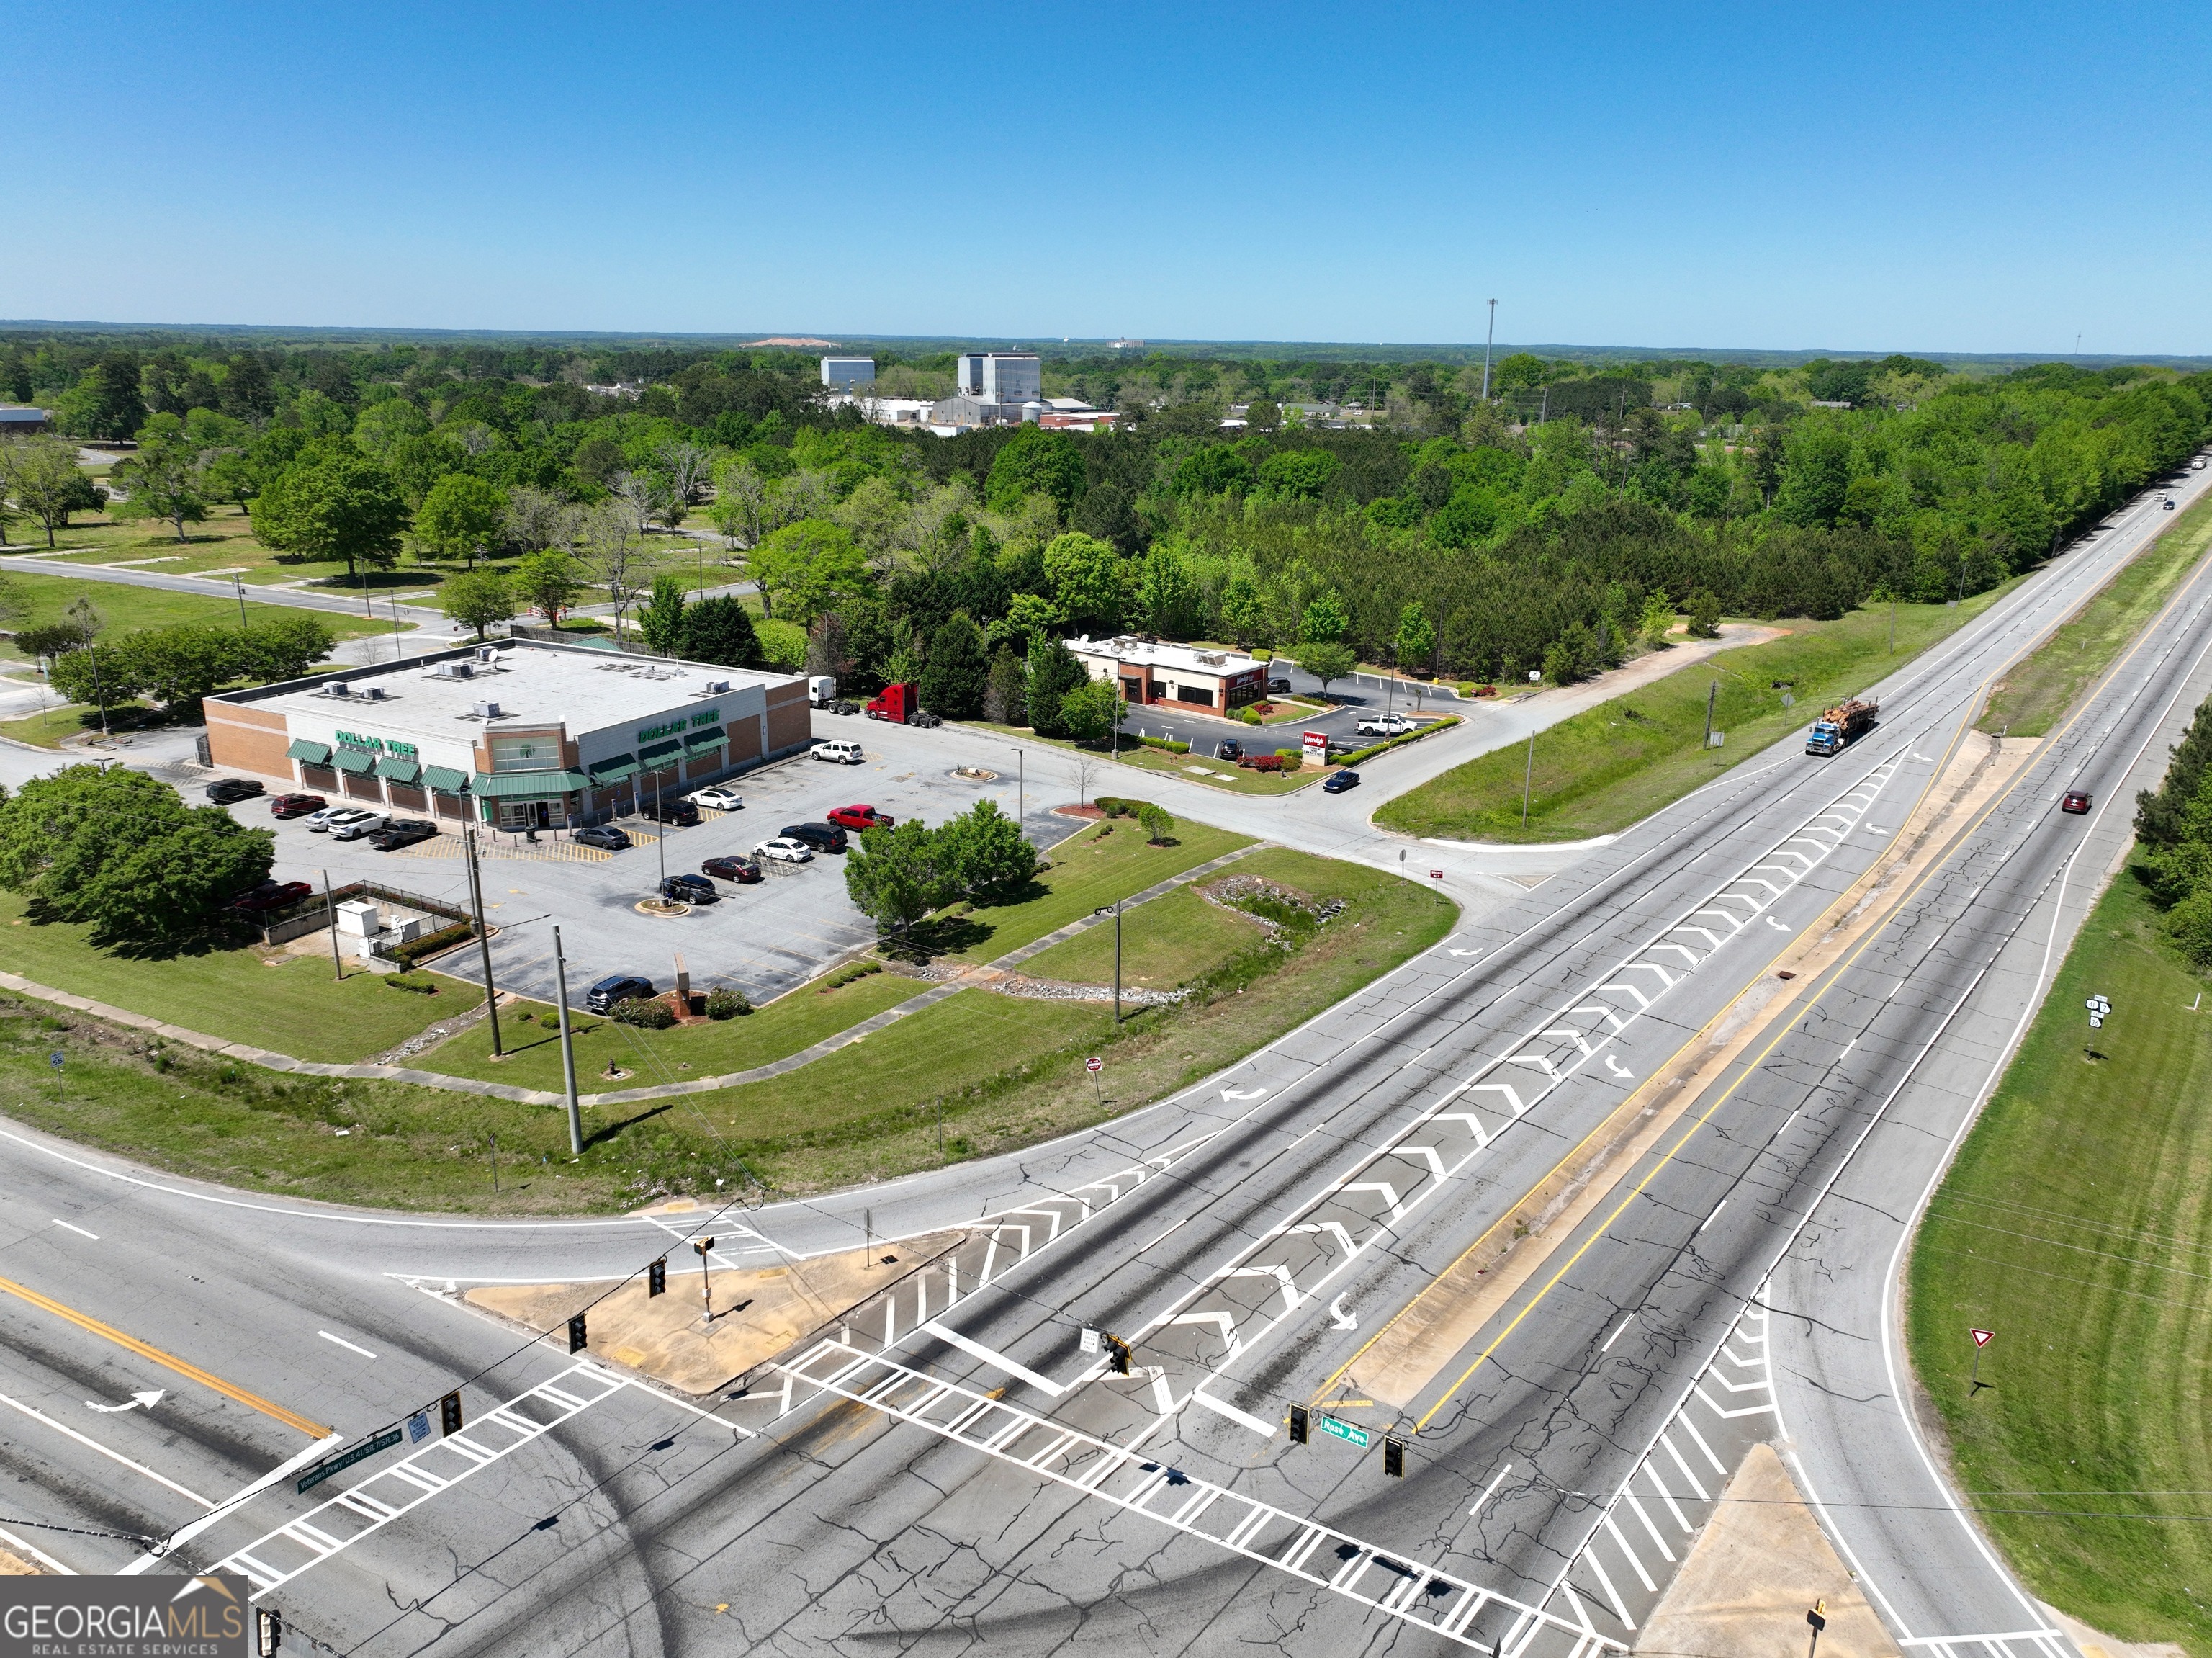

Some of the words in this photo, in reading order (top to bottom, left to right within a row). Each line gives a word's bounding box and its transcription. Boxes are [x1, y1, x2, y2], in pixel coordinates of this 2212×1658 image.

[639, 719, 687, 744] DOLLAR
[691, 709, 721, 727] TREE
[335, 729, 382, 750] DOLLAR
[385, 739, 416, 756] TREE
[53, 1057, 63, 1066] 55
[1323, 1420, 1344, 1435] Rose
[1347, 1430, 1365, 1443] Ave
[300, 1470, 325, 1489] Veterans
